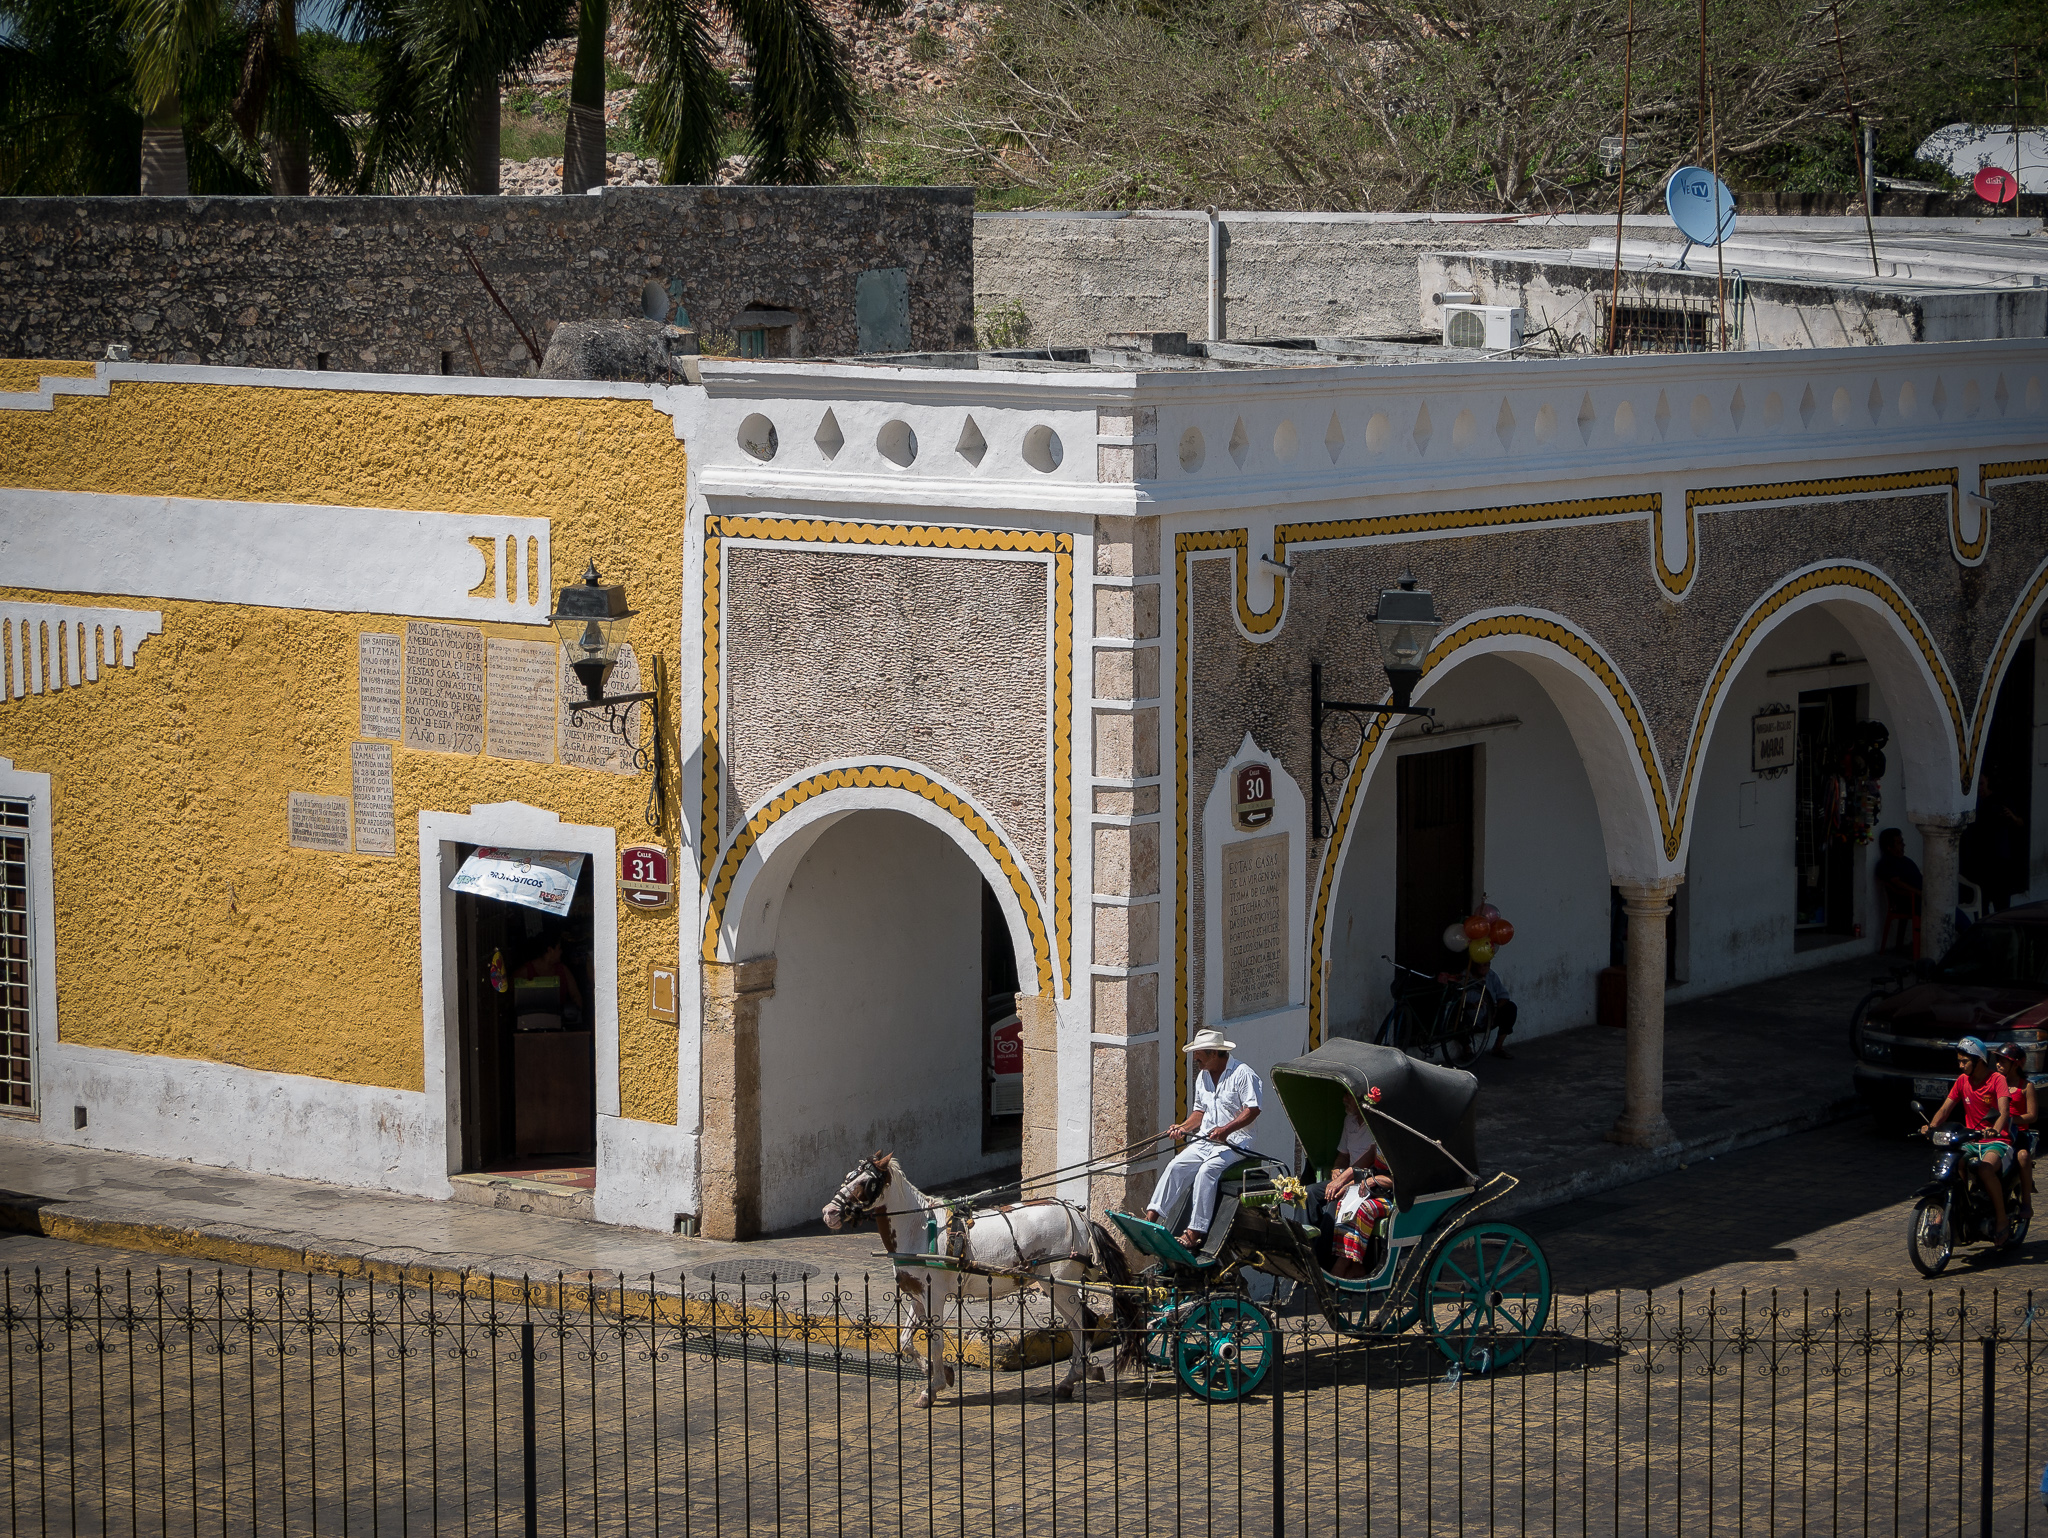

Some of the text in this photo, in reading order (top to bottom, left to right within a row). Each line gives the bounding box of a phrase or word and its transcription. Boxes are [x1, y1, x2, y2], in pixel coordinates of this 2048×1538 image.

[369, 647, 398, 657] ITZMAL
[436, 649, 450, 658] CON
[452, 650, 462, 660] LO
[472, 654, 482, 662] SE
[407, 656, 452, 668] REMEDIO LA
[412, 666, 434, 677] ESTAS
[436, 670, 460, 680] CASAS
[462, 672, 472, 682] SE
[620, 670, 630, 680] LO
[406, 676, 483, 692] ZIERON CON ASISTEN
[611, 681, 630, 692] OTRA
[444, 690, 482, 703] MARISCAL
[406, 706, 421, 715] ROA
[413, 697, 448, 708] ANTONIO
[451, 702, 461, 711] DE
[380, 716, 400, 725] MARCOS
[433, 719, 453, 730] ESTA
[456, 722, 483, 734] PROVIN
[410, 726, 434, 744] AÑO
[452, 732, 481, 753] 1730
[1246, 778, 1264, 800] 30
[355, 801, 386, 810] EPISCOPALES
[379, 811, 394, 819] CASTRO
[368, 819, 394, 827] ARZOBISPO
[632, 859, 657, 881] 31
[1229, 853, 1278, 875] ESTAS CASAS
[1230, 878, 1238, 889] DE
[1239, 876, 1247, 887] LA
[1248, 870, 1269, 885] VIRGEN
[1230, 882, 1279, 903] TISIMA DE YZAMAL
[1230, 896, 1280, 916] SE TECHARON TO
[1231, 959, 1242, 971] CON
[1243, 954, 1267, 968] LICENCIA
[1240, 992, 1252, 1004] AÑO
